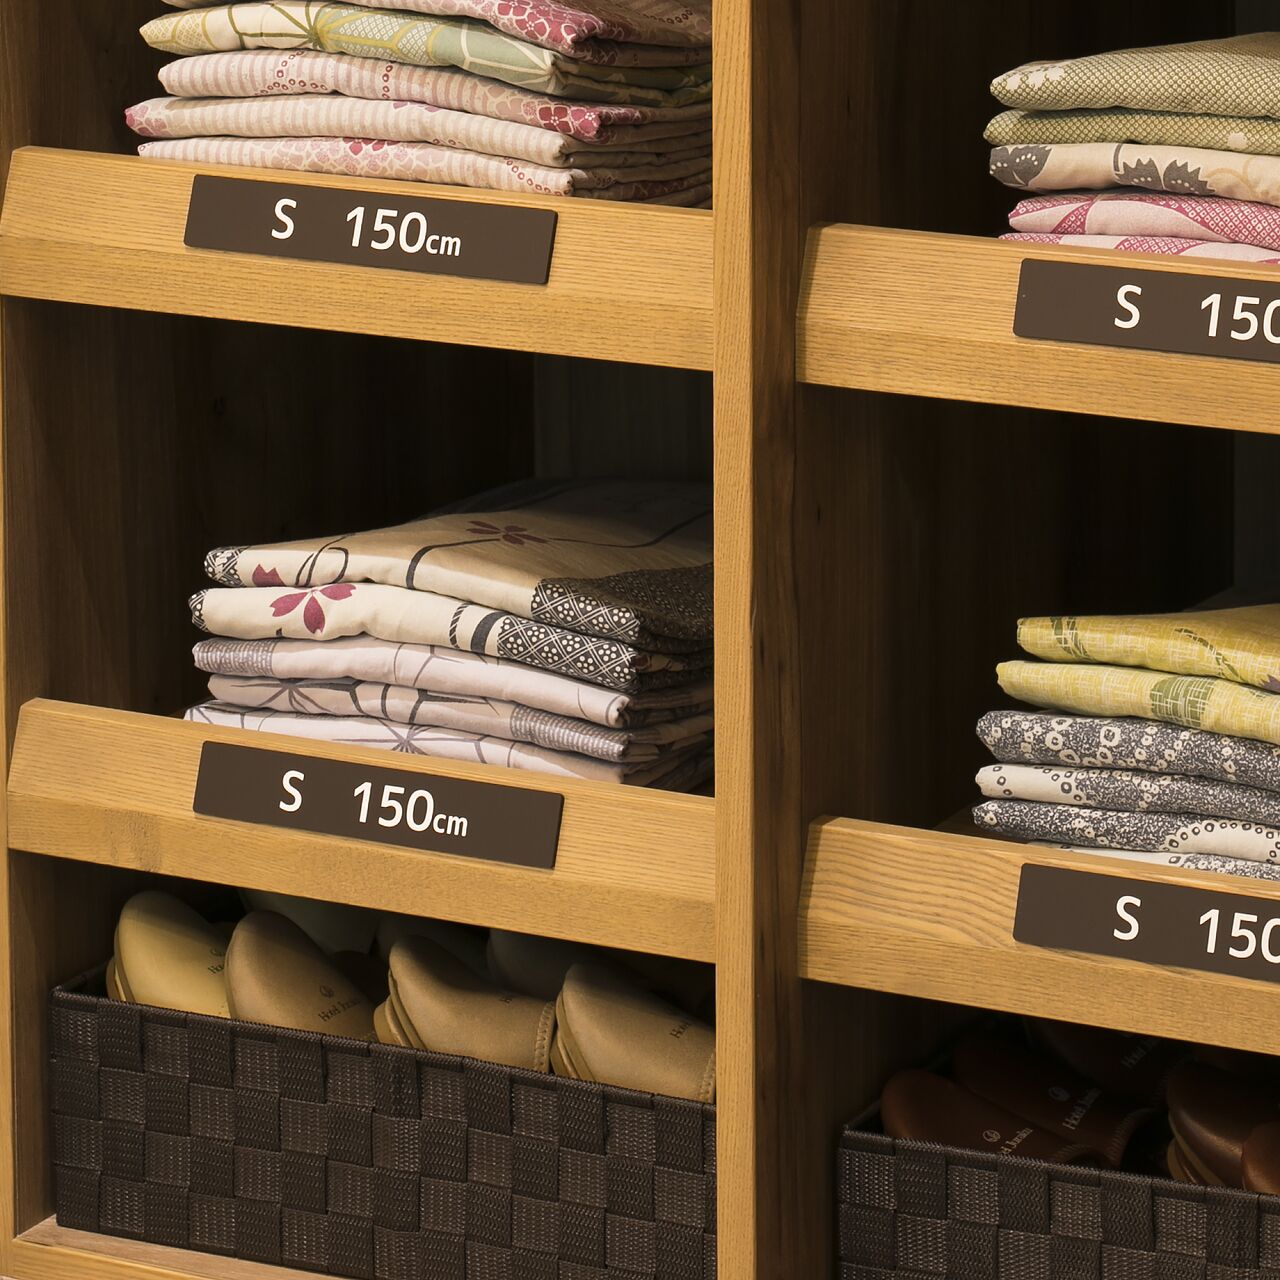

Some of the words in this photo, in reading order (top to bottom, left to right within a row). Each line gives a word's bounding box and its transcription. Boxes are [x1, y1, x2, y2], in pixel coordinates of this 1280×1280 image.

[270, 198, 298, 240] S
[345, 205, 462, 257] 150cm
[1113, 284, 1143, 329] S
[278, 769, 306, 812] S
[352, 781, 469, 838] 150cm
[1113, 895, 1142, 941] S
